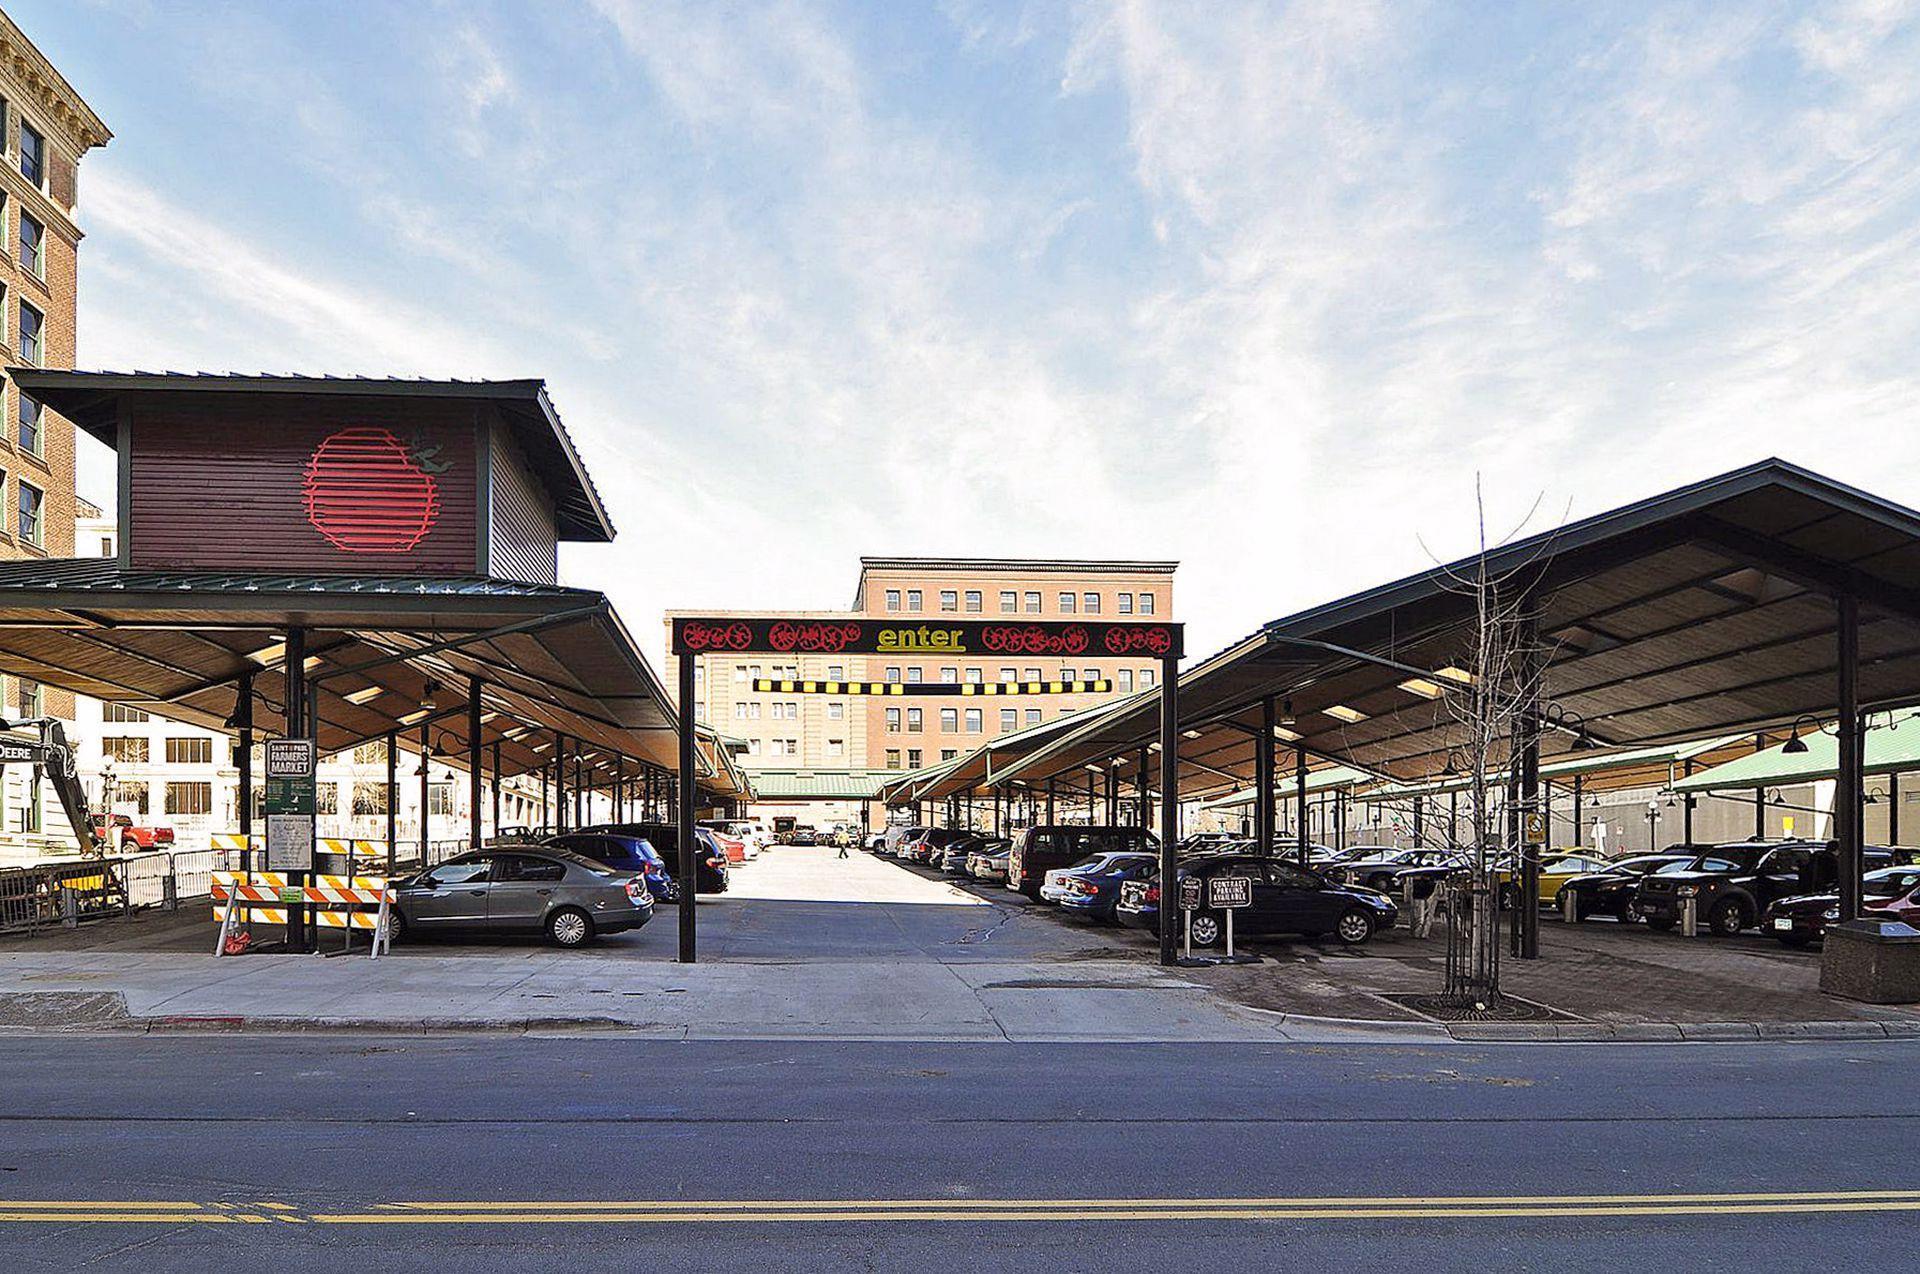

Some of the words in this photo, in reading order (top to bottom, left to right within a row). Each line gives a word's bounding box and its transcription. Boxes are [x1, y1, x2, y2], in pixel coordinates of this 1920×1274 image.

[878, 625, 963, 647] enter
[271, 761, 308, 773] MARKET
[1213, 880, 1247, 888] CONTRACT
[1213, 893, 1246, 901] AVAILABLE
